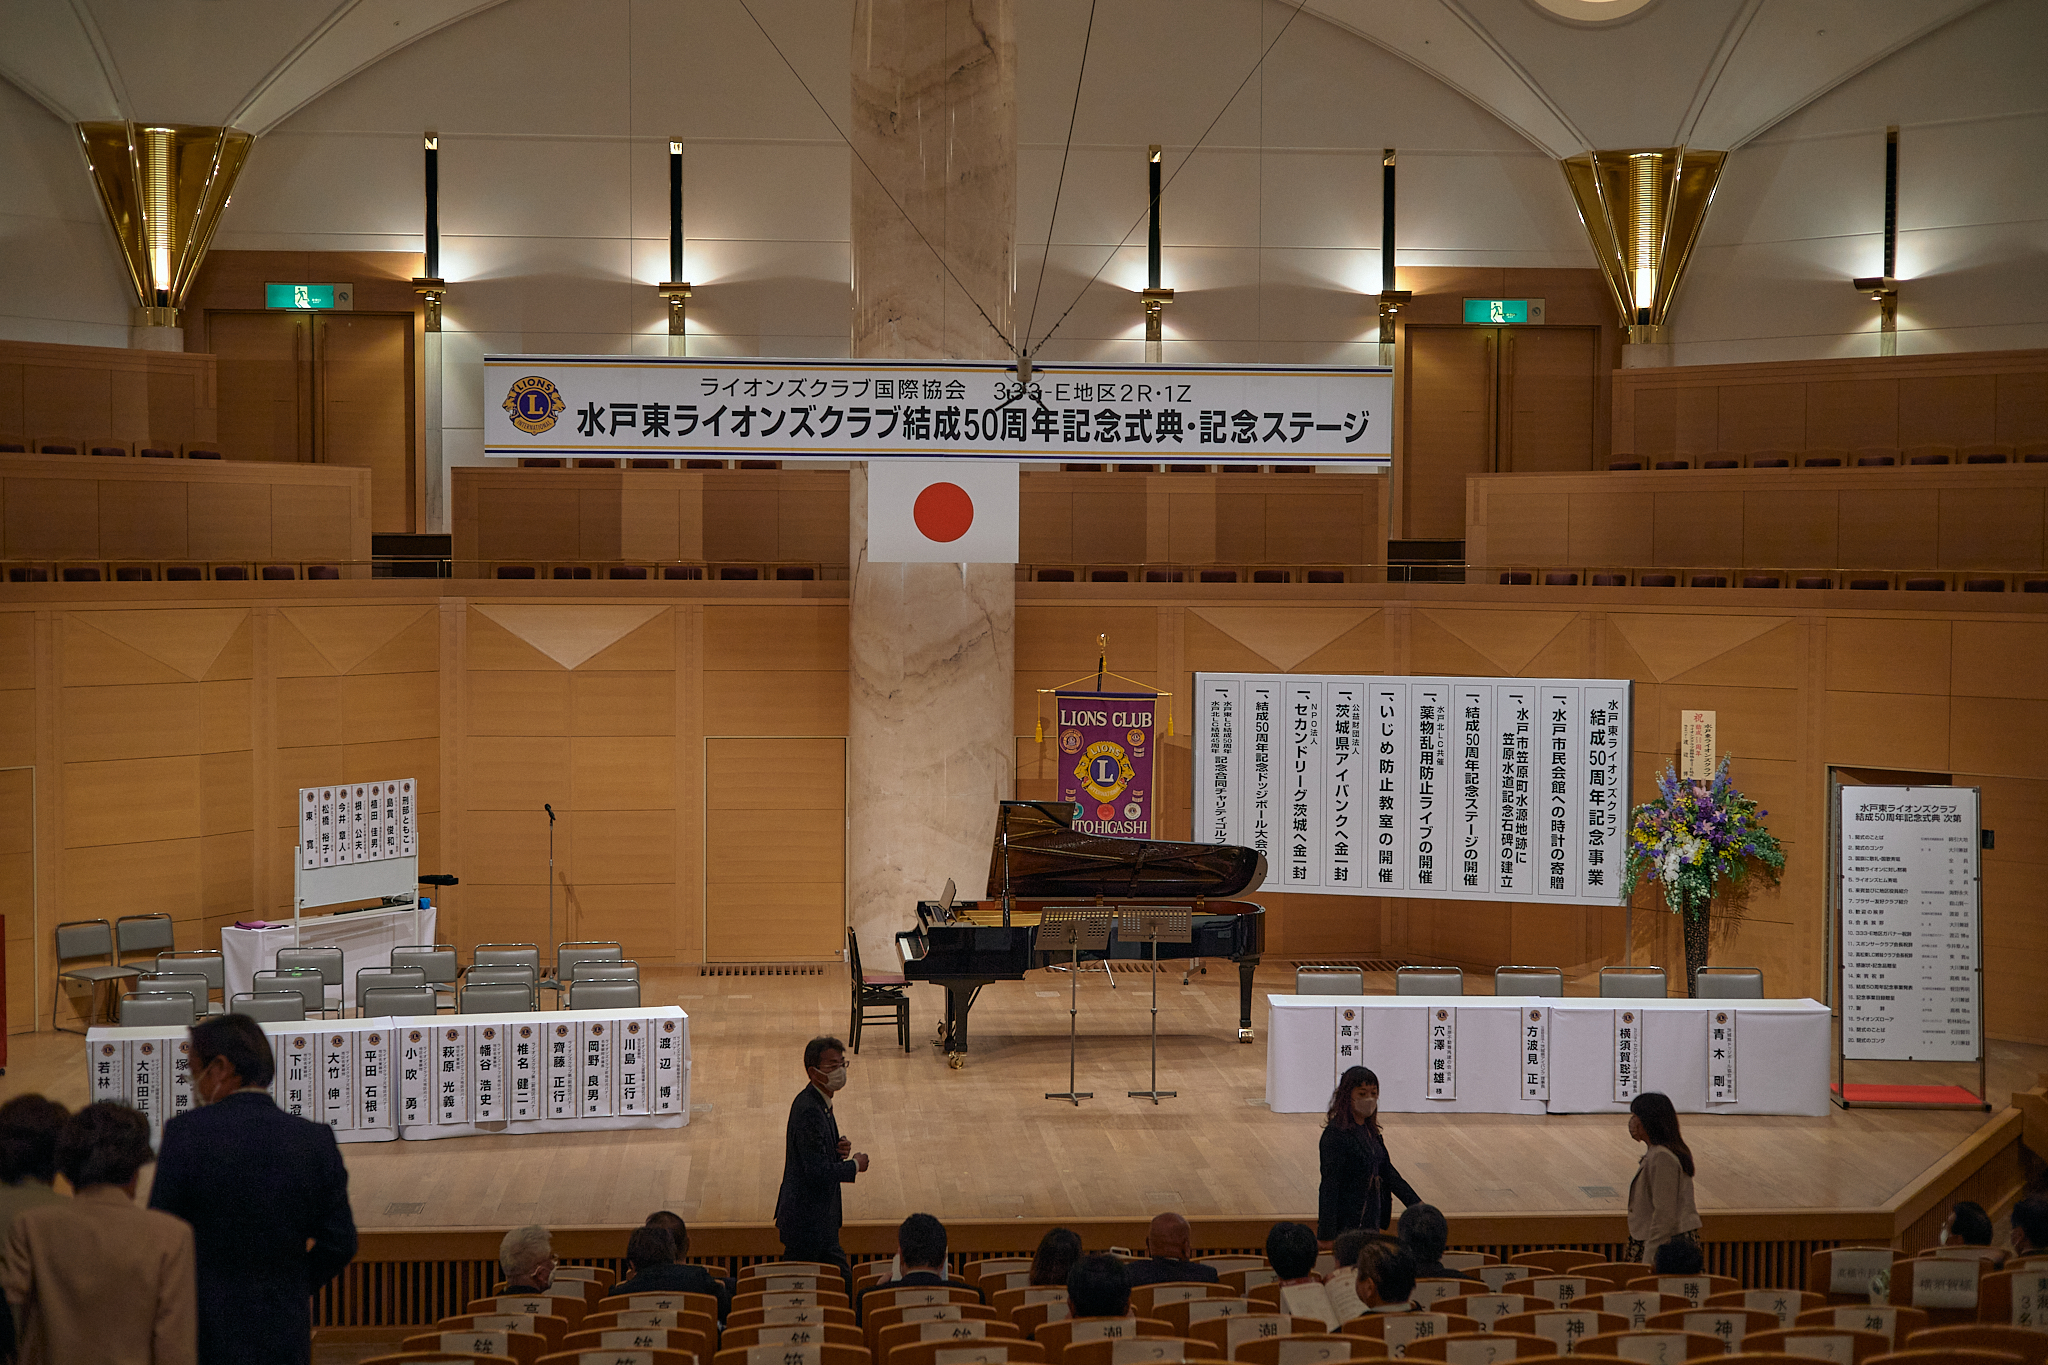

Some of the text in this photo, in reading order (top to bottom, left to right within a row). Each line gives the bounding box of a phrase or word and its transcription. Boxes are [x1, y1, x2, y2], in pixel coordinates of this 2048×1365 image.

[515, 378, 553, 392] LIONS
[700, 377, 966, 401] ライオンズクラブ国際協会
[527, 395, 543, 415] L
[515, 418, 554, 431] INTERNATIONAL
[1060, 710, 1153, 728] LIONS CLUB
[1310, 703, 1318, 745] NPO法人
[1352, 704, 1360, 755] 公益財団法人
[1090, 745, 1121, 757] LIONS
[1097, 760, 1114, 782] L
[1607, 700, 1619, 837] 水戸東ライオンズクラブ
[1588, 709, 1606, 886] 結成50周年記念事業
[1860, 803, 1957, 814] 水戸東ライオンズクラブ
[1072, 820, 1148, 834] ITO HIGASHI
[1855, 813, 1962, 823] 結成50周年記念式典 次第
[1341, 1025, 1352, 1060] 高橋
[1436, 1286, 1446, 1298] 北
[1497, 1302, 1510, 1316] 水
[1633, 1299, 1646, 1329] 水戸
[1865, 1316, 1883, 1333] 神
